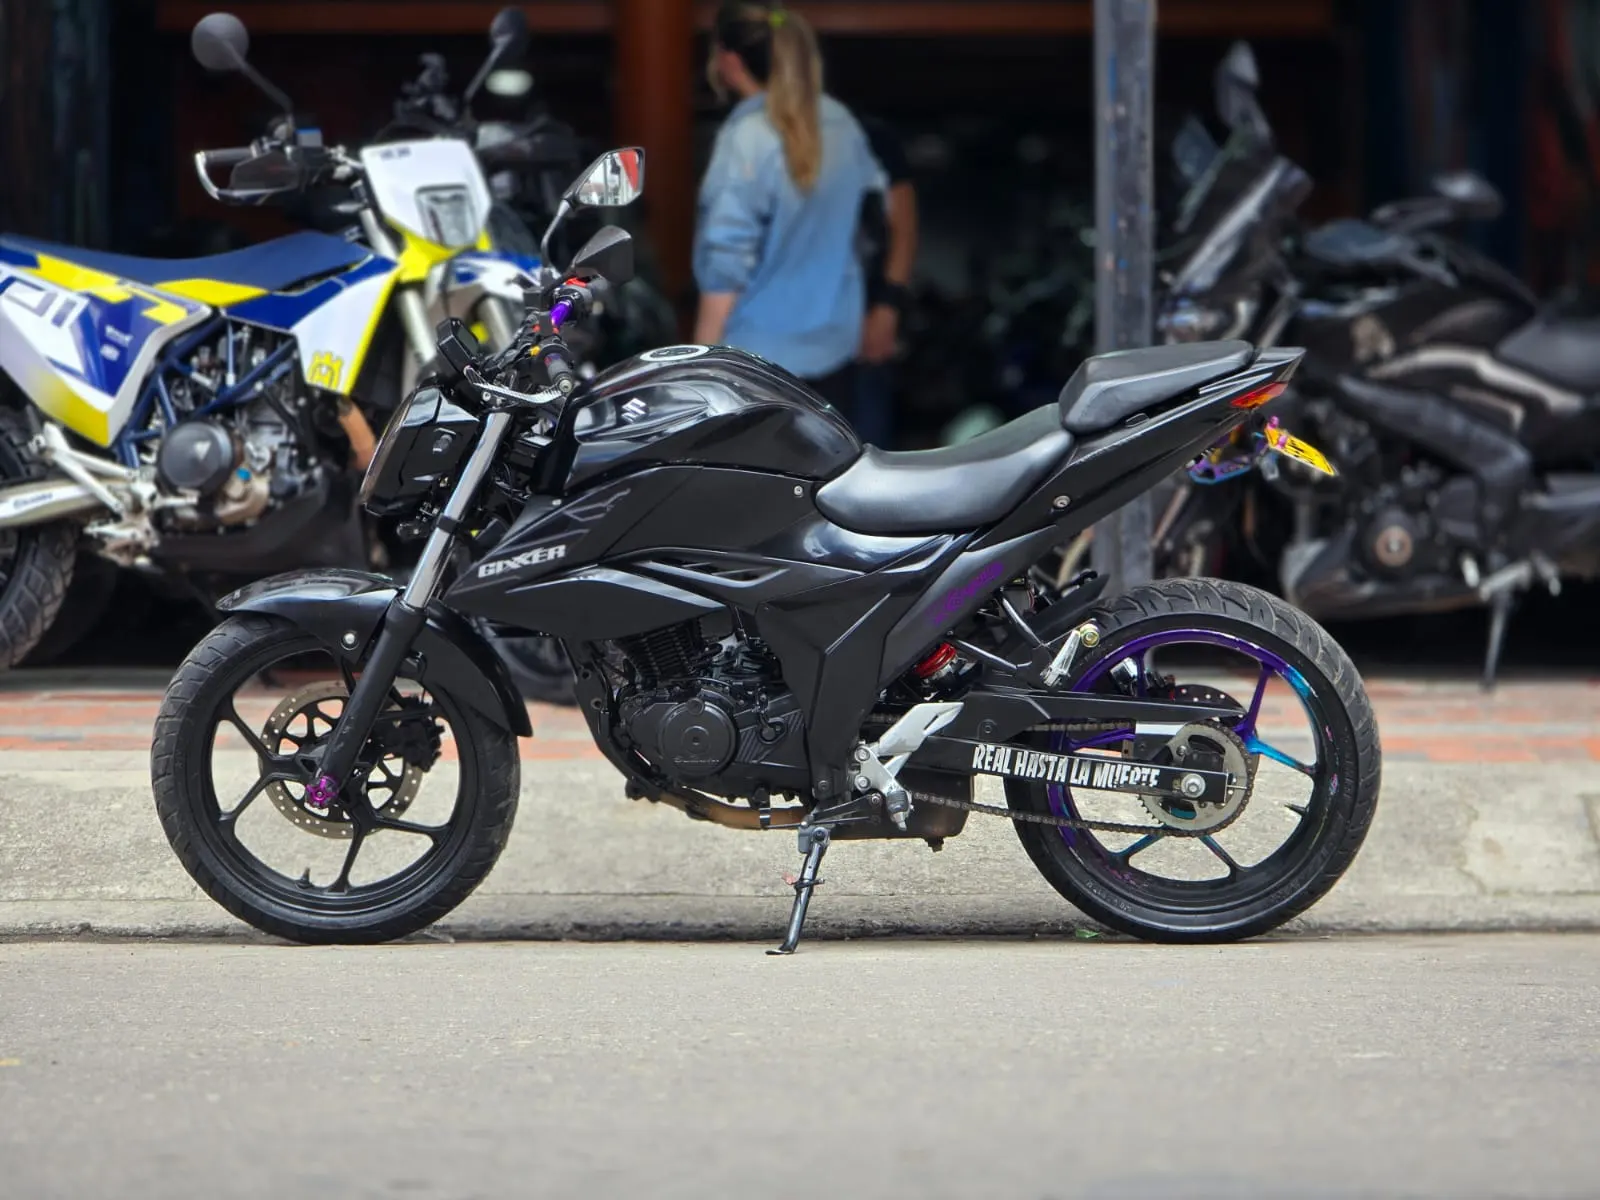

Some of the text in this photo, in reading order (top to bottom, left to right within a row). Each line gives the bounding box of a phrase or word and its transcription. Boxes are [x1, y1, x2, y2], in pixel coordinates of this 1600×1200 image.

[477, 544, 567, 579] GIXXER
[972, 743, 1161, 789] REAL HASTA LA MUERTE
